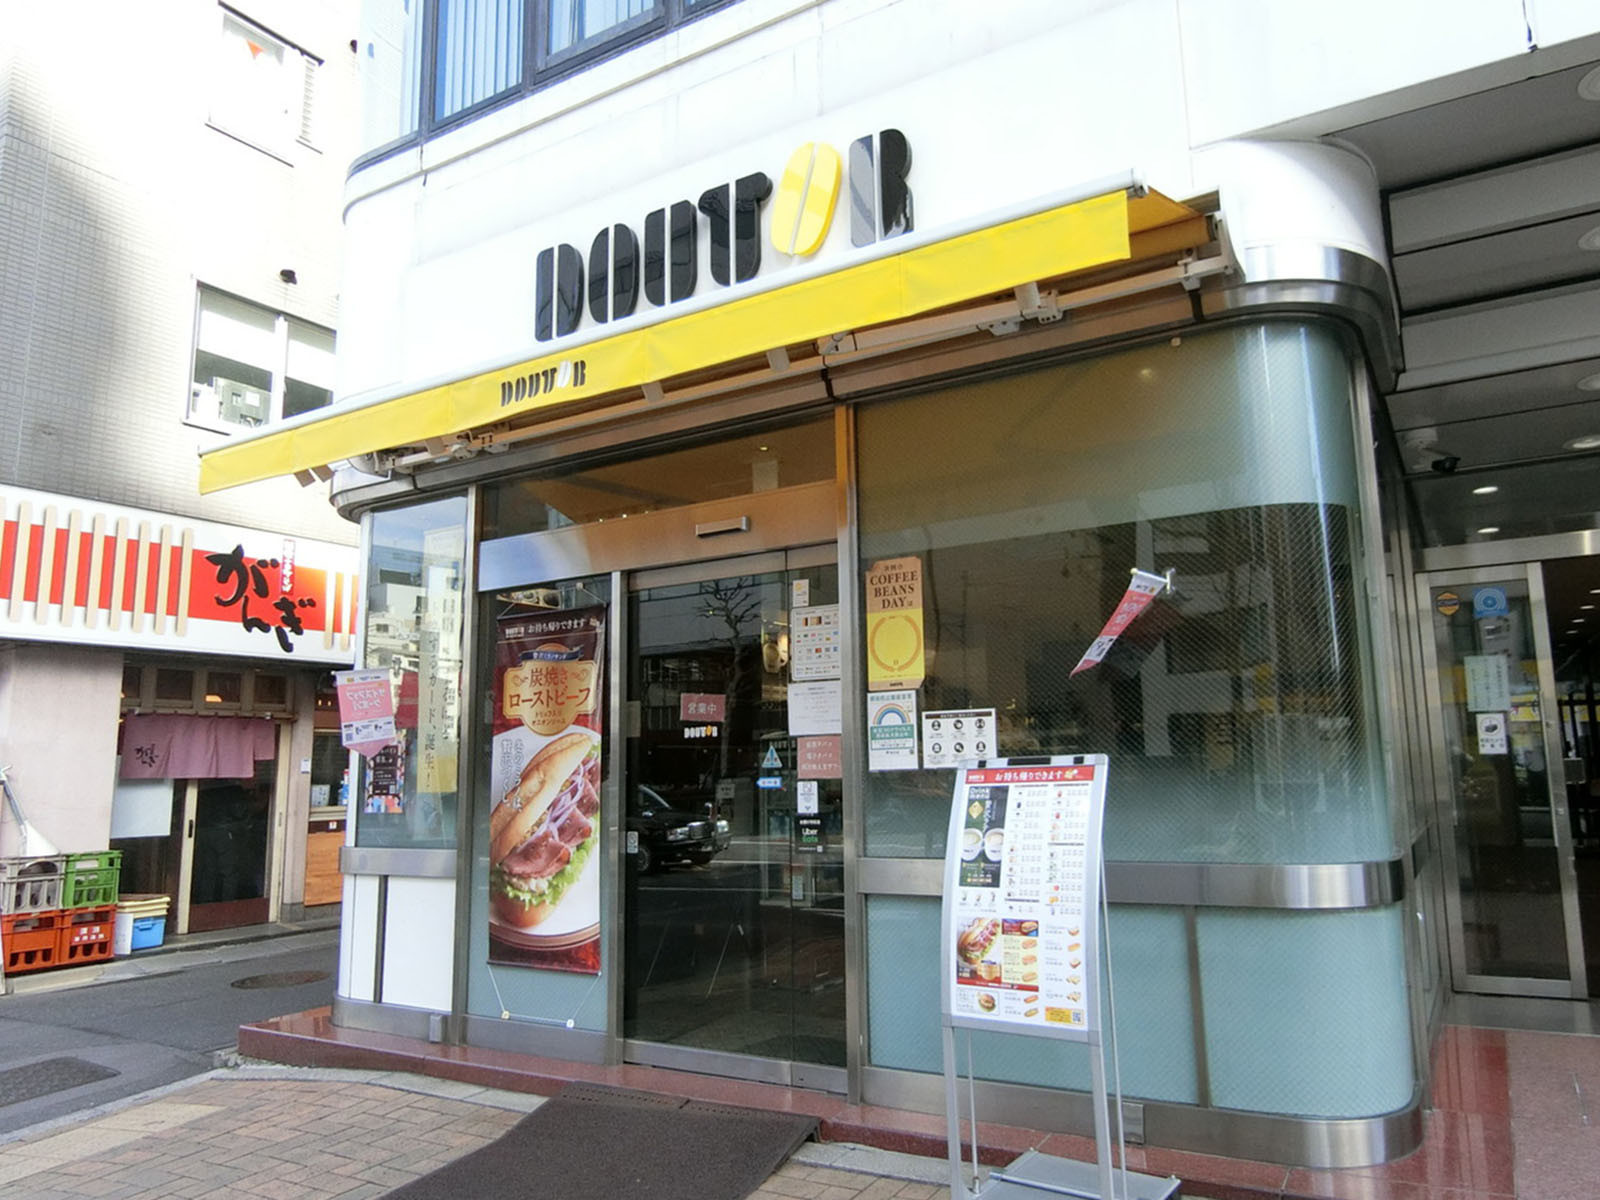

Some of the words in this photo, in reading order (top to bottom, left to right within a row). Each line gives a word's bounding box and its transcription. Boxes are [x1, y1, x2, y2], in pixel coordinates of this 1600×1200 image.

[535, 128, 915, 342] DOUTOR
[501, 360, 587, 407] DOUTOR
[870, 571, 918, 586] COFFEE
[205, 544, 316, 653] がんぎ
[874, 584, 914, 598] BEANS
[882, 597, 907, 609] DAY
[529, 666, 569, 688] 炭焼き
[509, 685, 591, 709] ローストビーフ
[688, 701, 717, 715] 営業中
[684, 725, 718, 739] DOUTOR
[995, 770, 1063, 781] お持ち帰りできます
